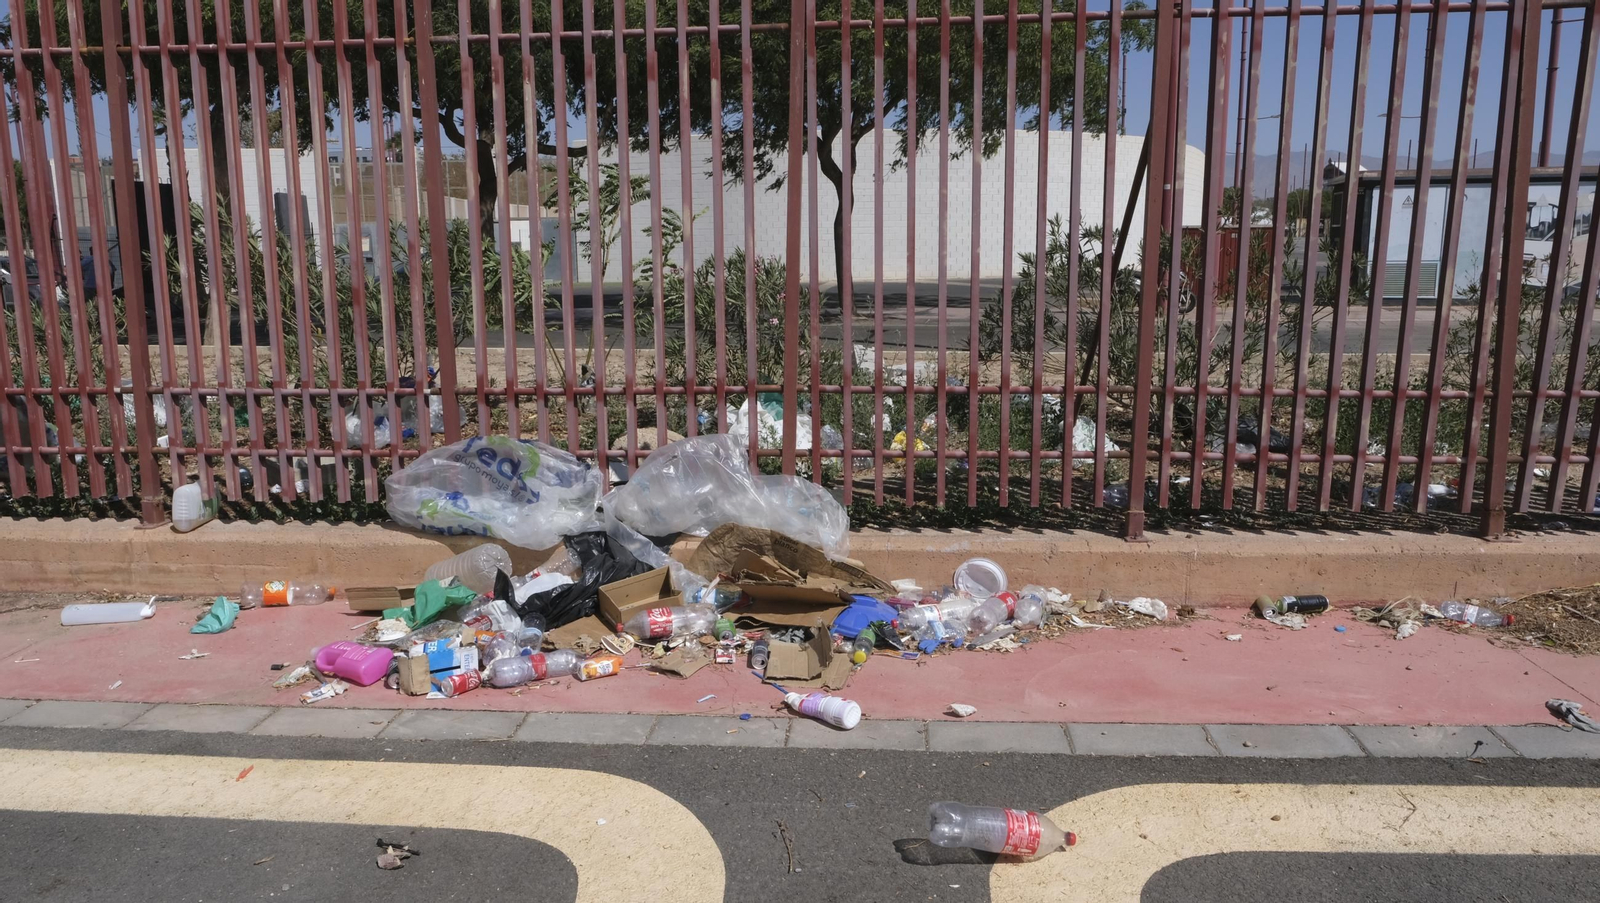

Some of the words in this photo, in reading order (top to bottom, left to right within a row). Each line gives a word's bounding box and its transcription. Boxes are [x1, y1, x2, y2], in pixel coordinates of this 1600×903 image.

[453, 453, 482, 474] grupo
[481, 471, 510, 492] moya
[774, 537, 799, 554] blanco
